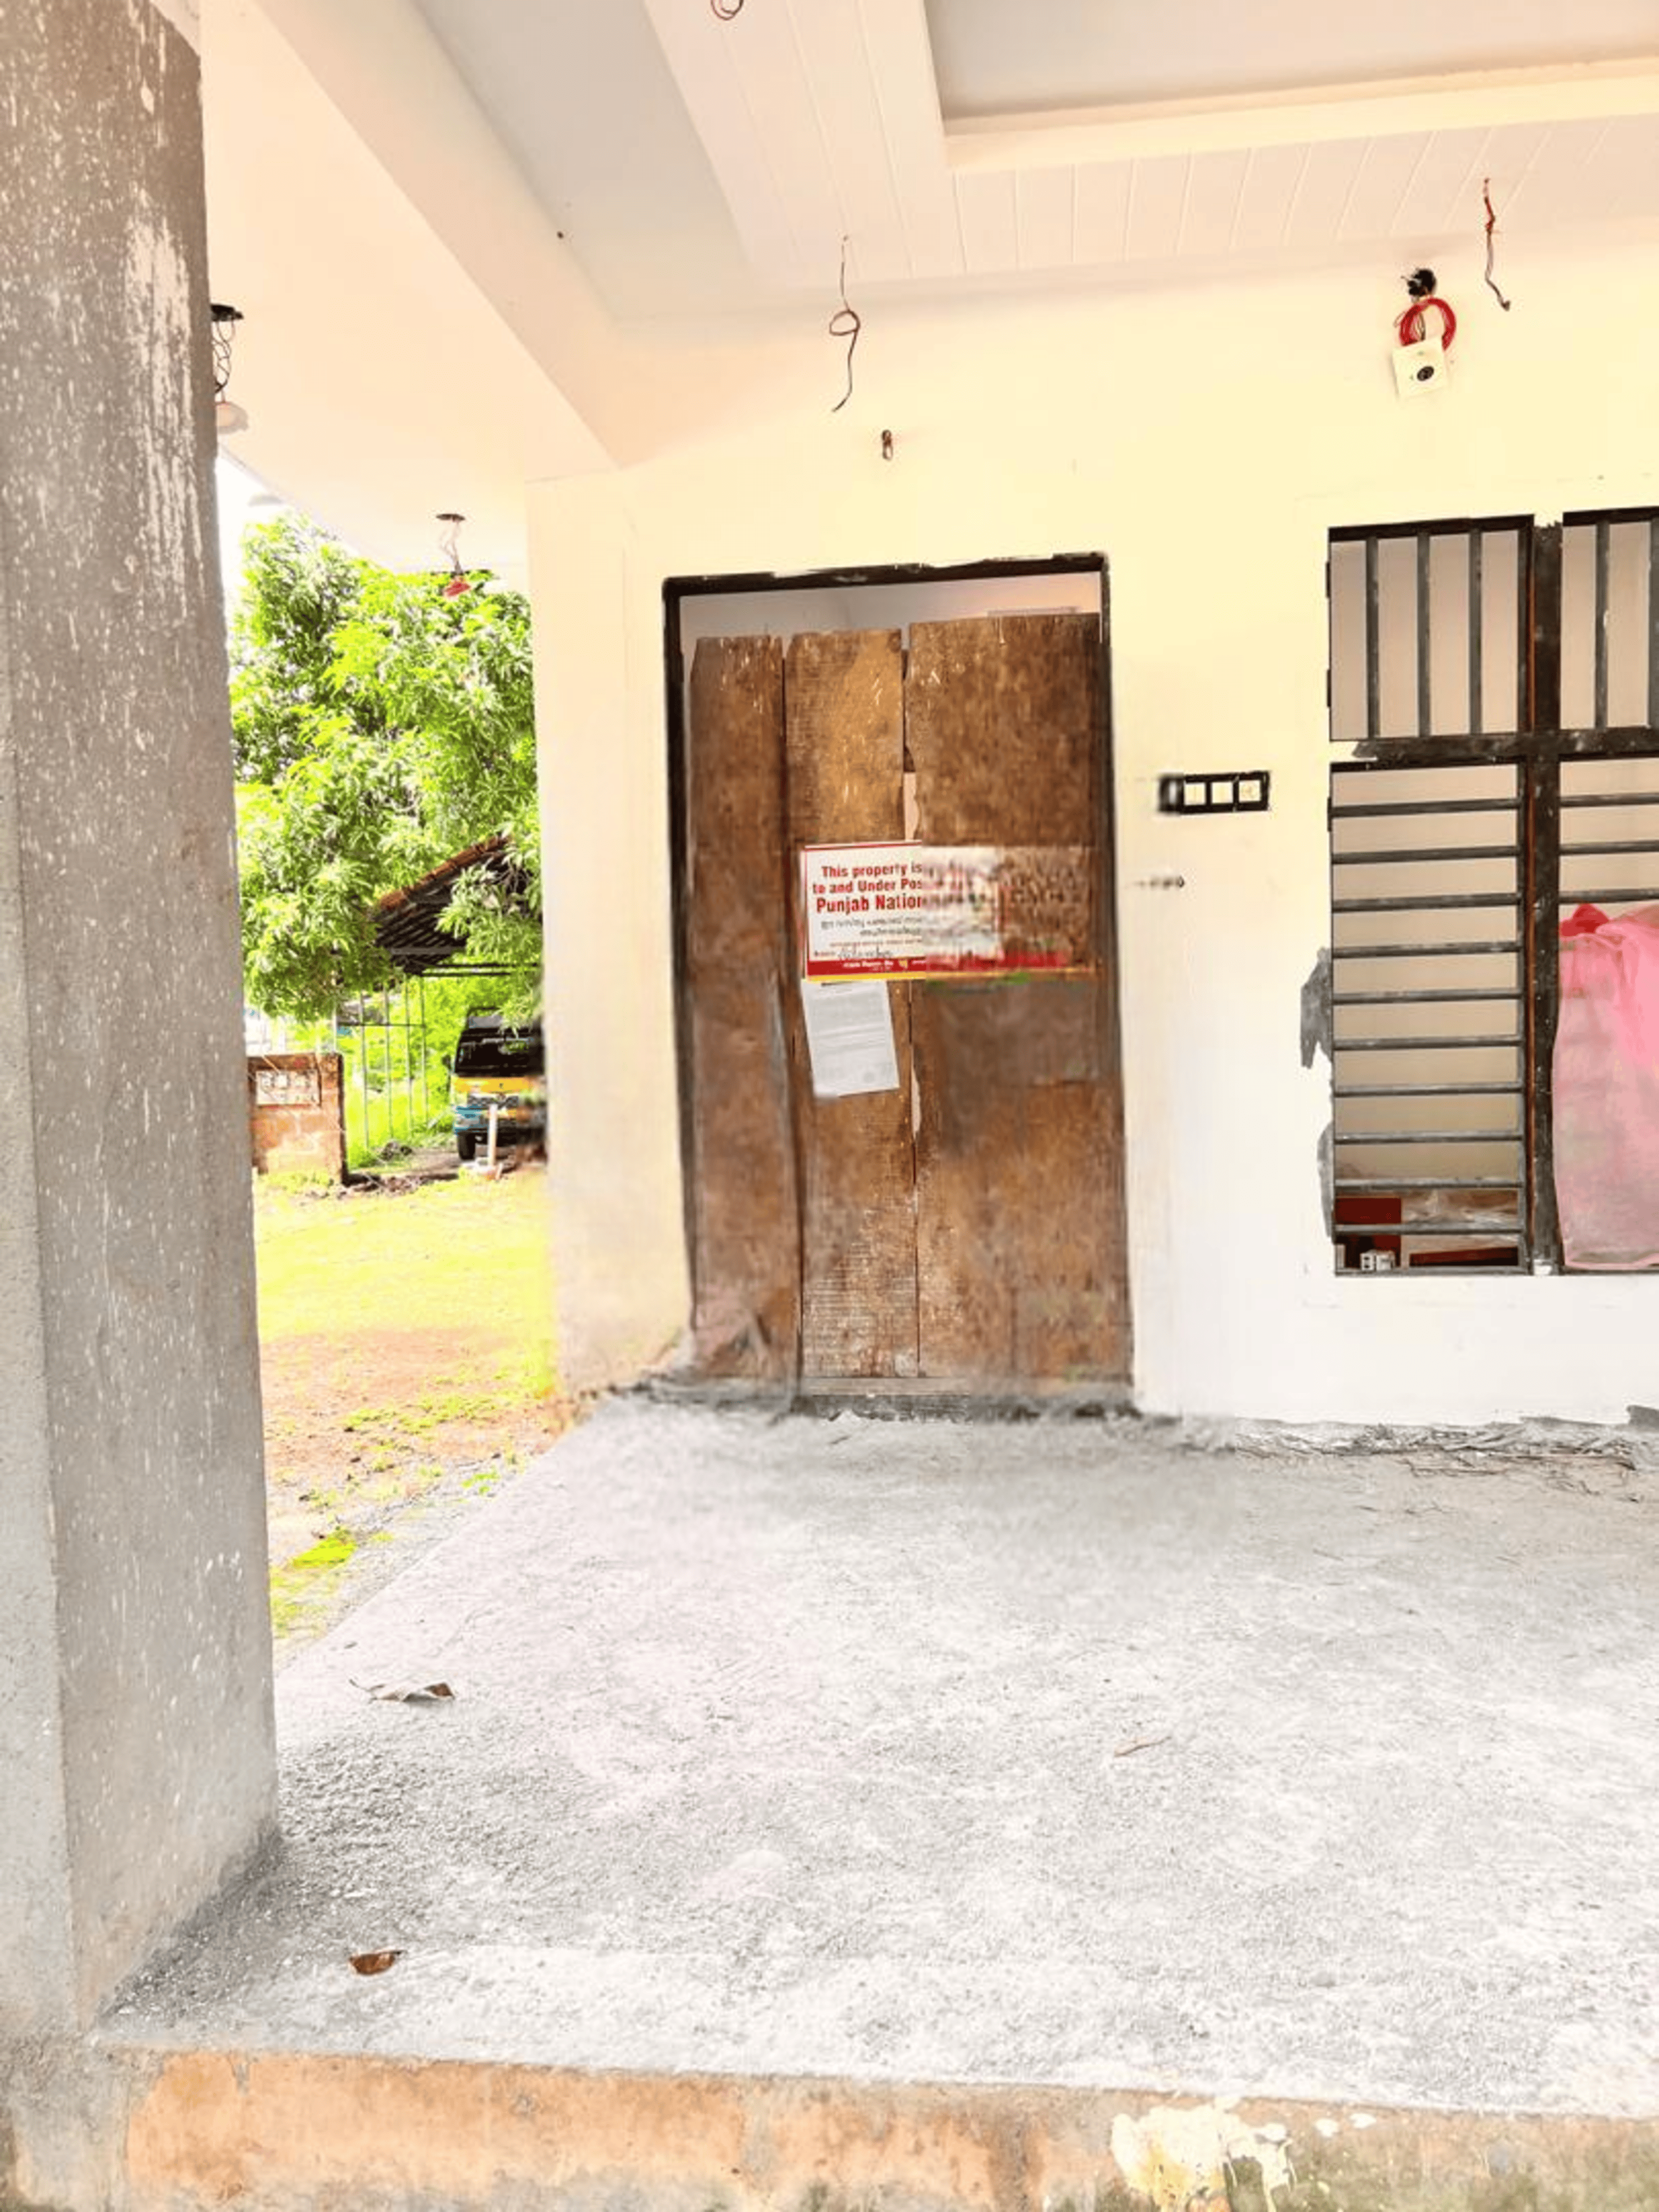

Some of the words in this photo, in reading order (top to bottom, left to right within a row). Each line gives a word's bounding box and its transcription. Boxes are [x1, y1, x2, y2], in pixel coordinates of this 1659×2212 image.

[821, 865, 848, 877] This
[852, 864, 907, 879] property
[813, 882, 826, 894] to
[829, 881, 853, 893] and
[858, 879, 895, 892] Under
[816, 896, 869, 915] Punjab
